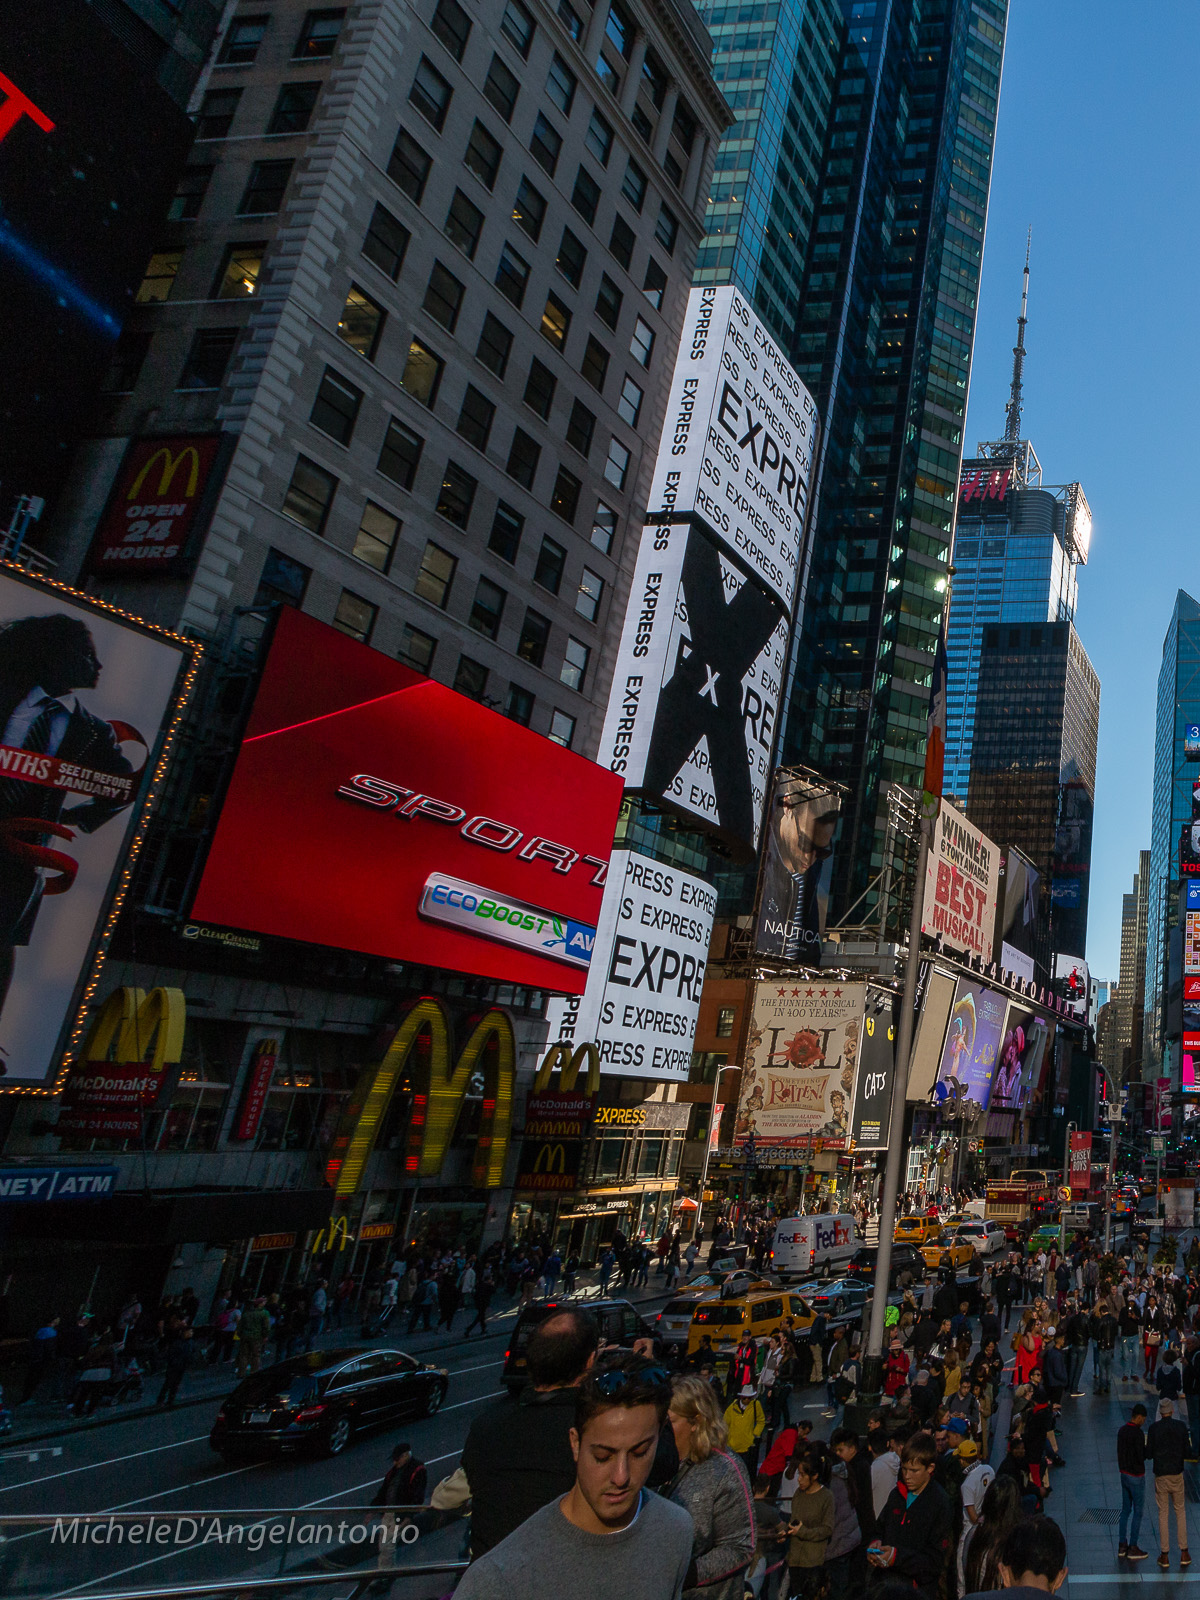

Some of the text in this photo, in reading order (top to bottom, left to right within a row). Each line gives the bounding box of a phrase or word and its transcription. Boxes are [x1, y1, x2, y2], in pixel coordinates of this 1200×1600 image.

[690, 287, 716, 360] EXPRESS
[754, 325, 800, 398] EXPRESS
[671, 378, 699, 456] EXPRESS
[744, 378, 791, 448] EXPRESS
[763, 368, 807, 437] EXPRESS
[126, 504, 187, 517] OPEN
[726, 481, 776, 546] EXPRESS
[745, 468, 791, 531] EXPRESS
[123, 520, 174, 542] 24
[103, 545, 181, 559] HOURS
[735, 527, 783, 587] EXPRESS
[633, 573, 663, 658] EXPRESS
[610, 675, 643, 772] EXPRESS
[53, 775, 120, 798] JANUARY
[58, 763, 81, 777] SEE
[81, 768, 93, 780] IT
[93, 770, 133, 790] BEFORE
[335, 773, 609, 888] SPORT
[942, 812, 991, 872] WINNER!
[941, 839, 989, 886] 6 TONY AWARDS
[935, 860, 987, 927] BEST
[641, 904, 704, 943] EXPRESS
[765, 919, 820, 944] NAUTICA
[932, 904, 984, 952] MUSICAL!
[761, 999, 856, 1008] THE FUNNIEST MUSICAL
[1011, 972, 1075, 1016] BROADWAY
[622, 1005, 688, 1038] EXPRESS
[773, 1008, 785, 1017] IN
[787, 1008, 805, 1017] 400
[761, 1028, 842, 1070] LOL
[69, 1076, 160, 1091] McDonald's
[256, 1059, 270, 1089] OPEN
[864, 1072, 887, 1100] CATS
[78, 1092, 138, 1102] Restaurant
[529, 1100, 592, 1109] McDonald's
[57, 1119, 139, 1130] OPEN 24 HOURS
[243, 1098, 261, 1135] HOURS
[594, 1107, 647, 1125] EXPRESS
[1071, 1148, 1091, 1162] JERSEY
[1073, 1161, 1087, 1171] BOYS
[59, 1176, 112, 1194] ATM
[607, 1200, 629, 1209] EXPRESS
[778, 1233, 808, 1244] FedEx
[816, 1220, 849, 1250] FedEx
